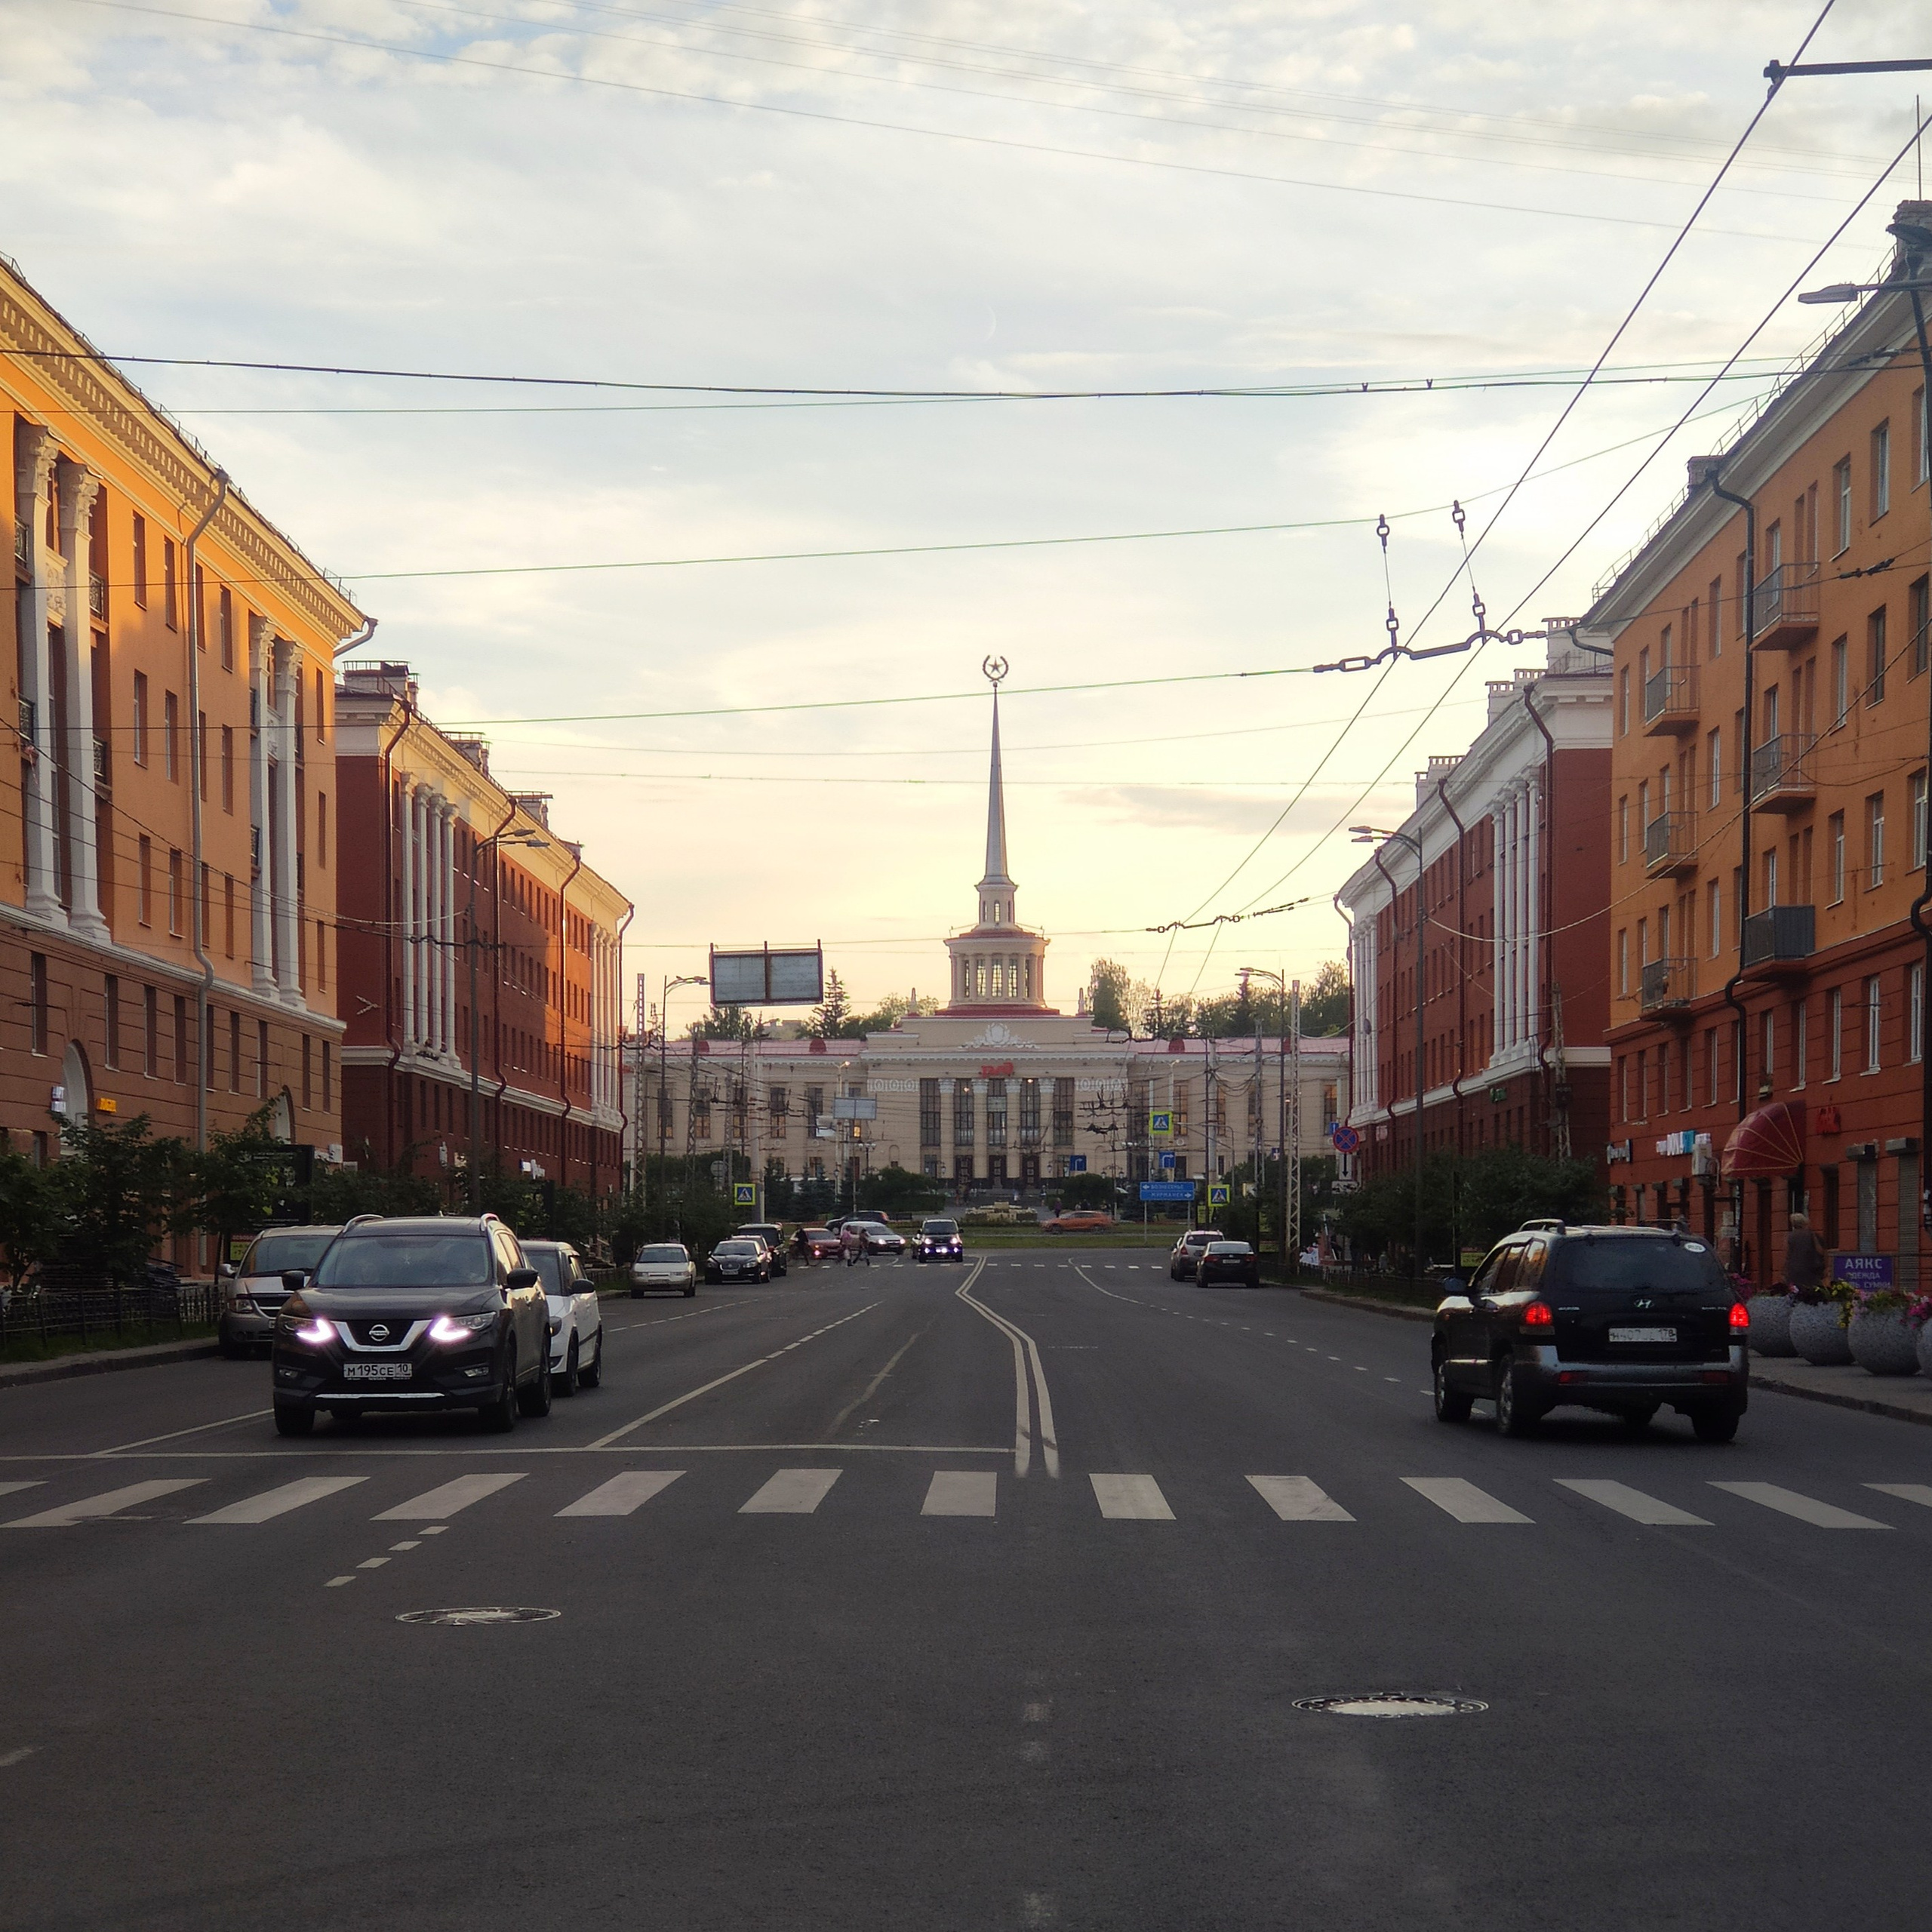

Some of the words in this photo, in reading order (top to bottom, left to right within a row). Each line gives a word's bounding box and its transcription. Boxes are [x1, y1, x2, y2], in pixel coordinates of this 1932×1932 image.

[1845, 1258, 1882, 1269] АЯКС
[347, 1364, 394, 1376] М195СЕ
[397, 1364, 408, 1373] 10
